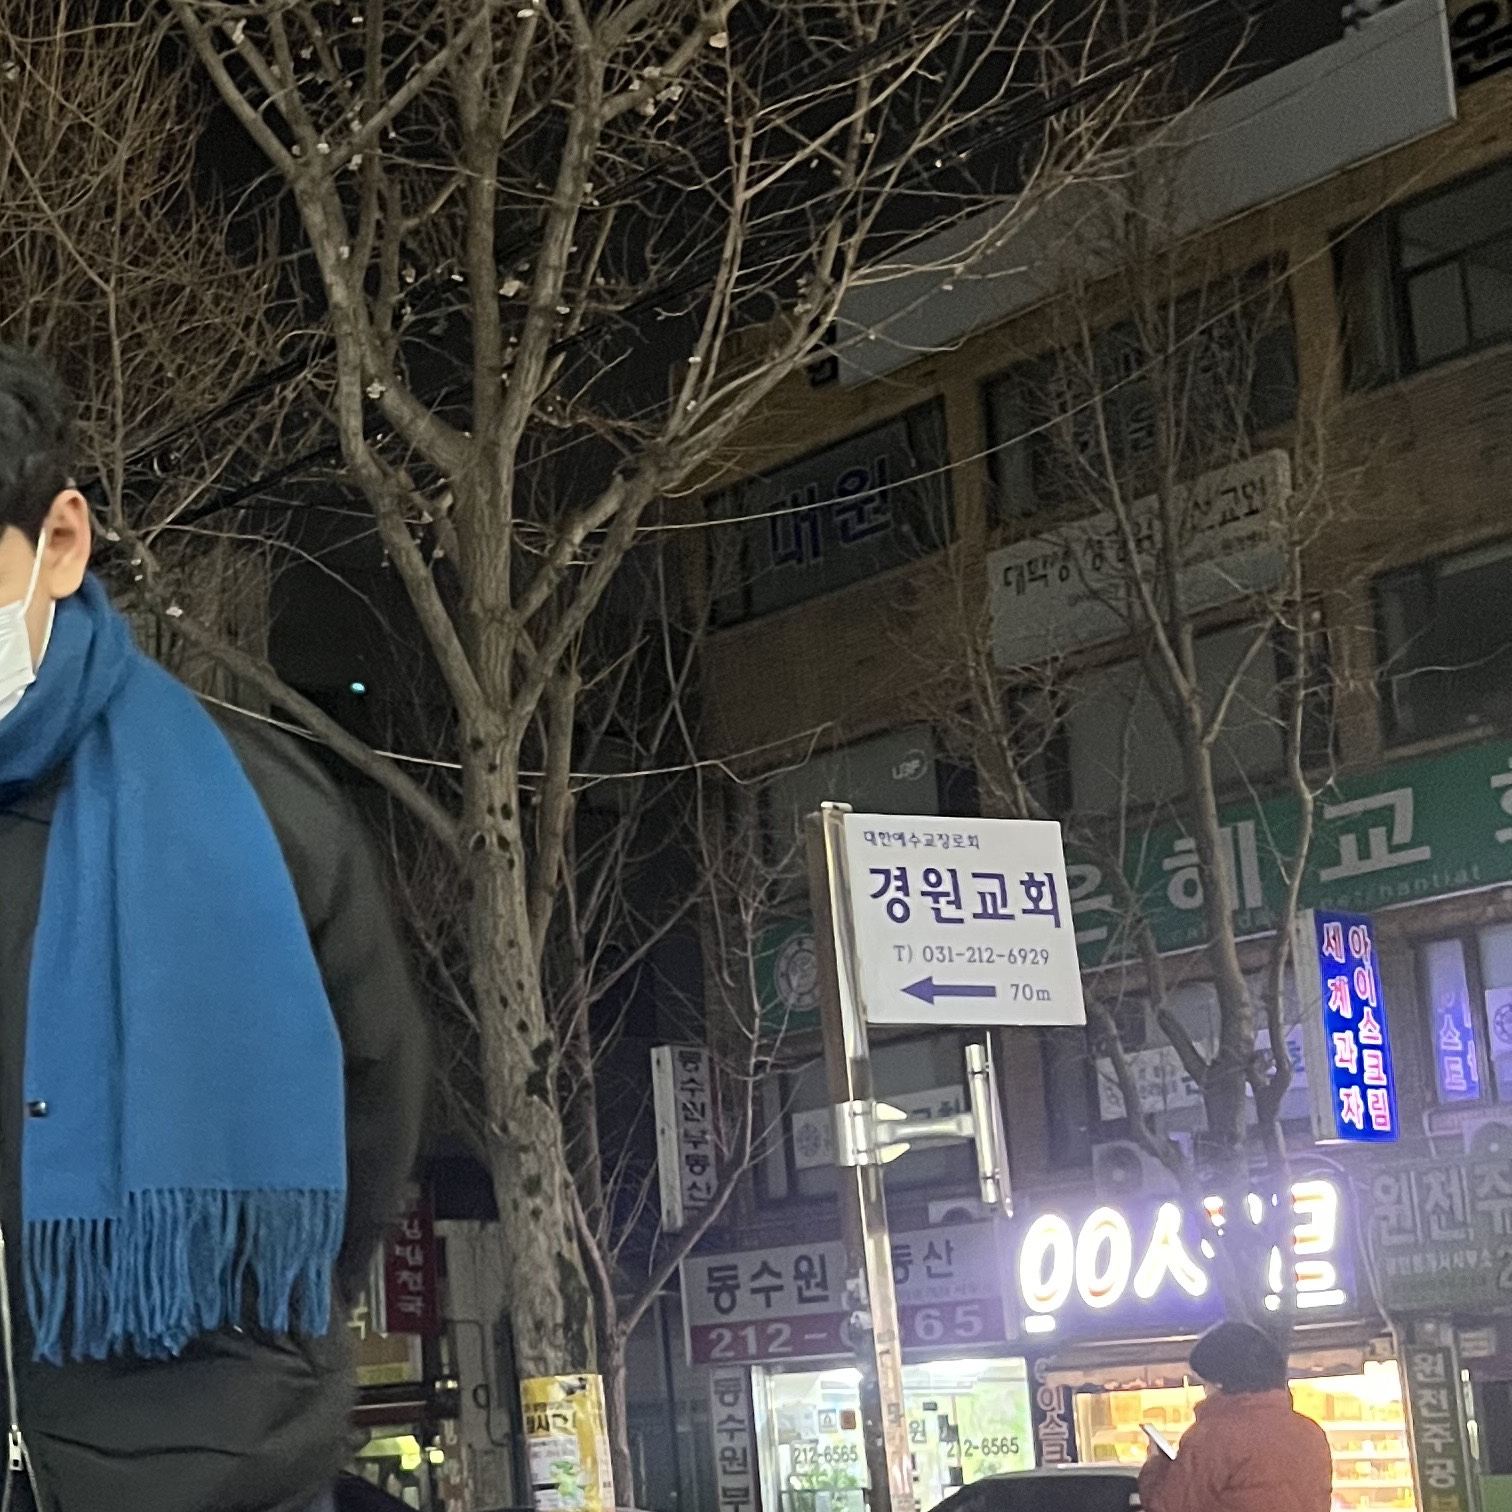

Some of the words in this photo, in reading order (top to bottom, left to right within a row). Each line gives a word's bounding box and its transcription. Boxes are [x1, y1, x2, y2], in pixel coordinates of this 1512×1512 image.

[869, 866, 1062, 929] 경원교회
[922, 945, 1050, 966] 031-212-6929
[1010, 983, 1052, 1001] 70m
[1347, 924, 1391, 1132] 아이스크림
[706, 1253, 830, 1315] 동수원
[708, 1303, 985, 1359] 212-65
[793, 1444, 859, 1466] 212-6565
[946, 1436, 1020, 1458] 22-6565
